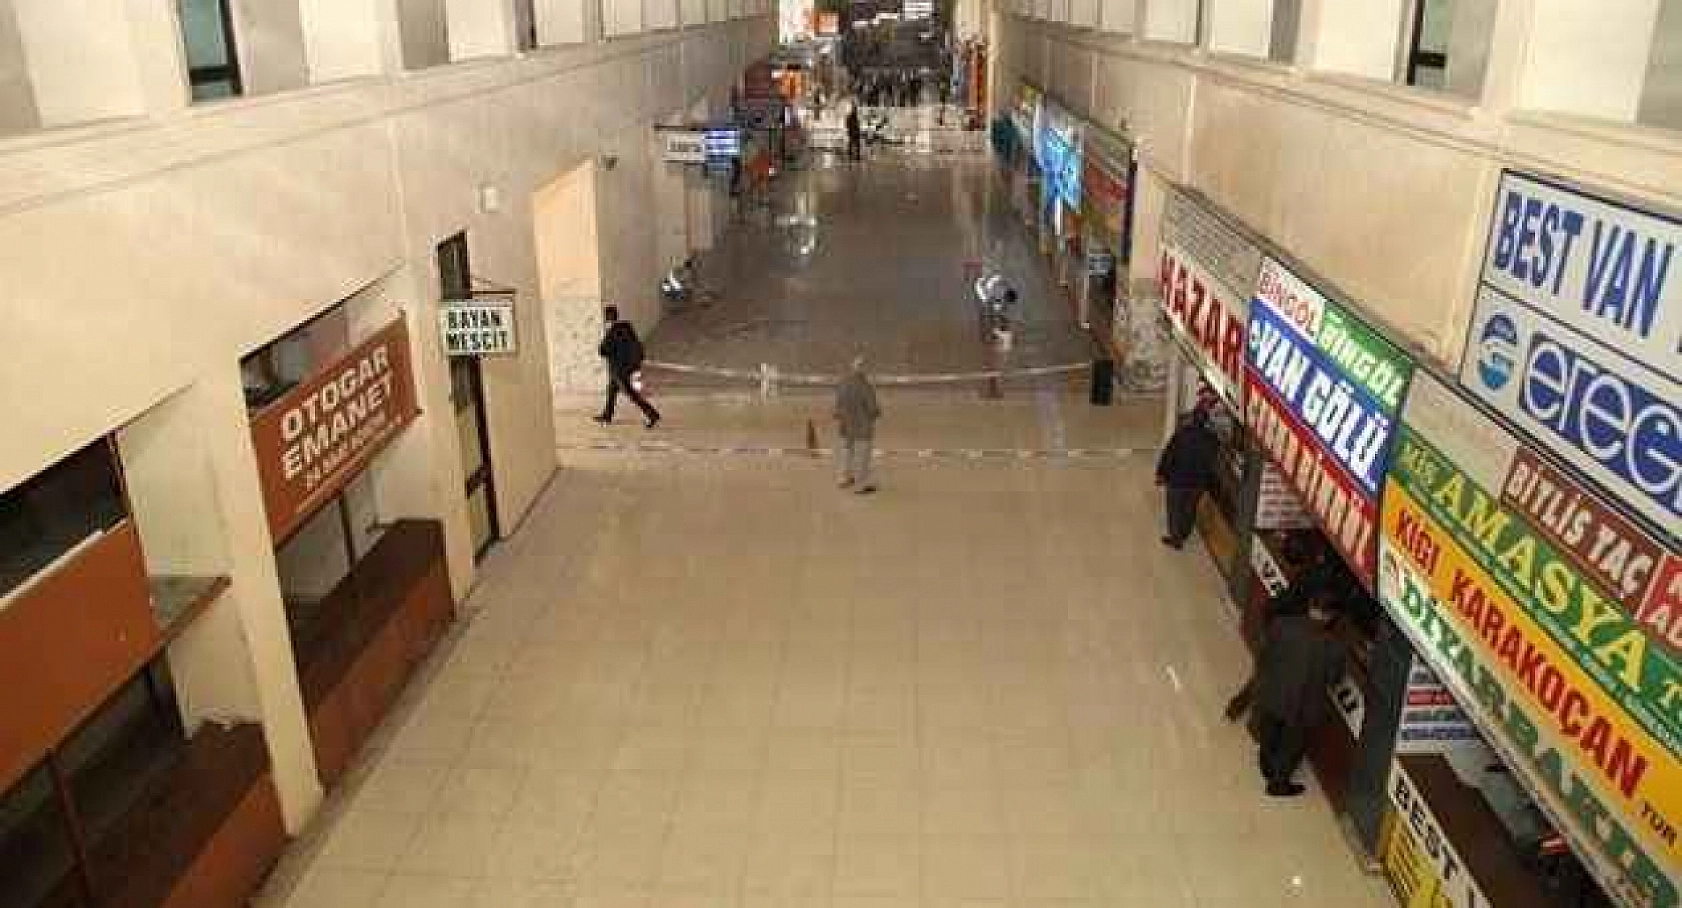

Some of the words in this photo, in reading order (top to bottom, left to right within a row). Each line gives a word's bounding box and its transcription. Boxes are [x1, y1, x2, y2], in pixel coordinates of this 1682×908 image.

[448, 310, 500, 329] BAYAN
[1161, 250, 1244, 385] HAZAR
[1494, 191, 1584, 296] BEST
[1583, 219, 1674, 339] VAN
[282, 346, 388, 441] OTOGAR
[282, 370, 392, 480] EMANET
[1257, 320, 1312, 402] VAN
[1302, 368, 1389, 480] GÖLÜ
[1431, 472, 1645, 693] AMASYA
[1453, 568, 1648, 799] KARAKOÇAN
[1396, 776, 1458, 881] BEST
